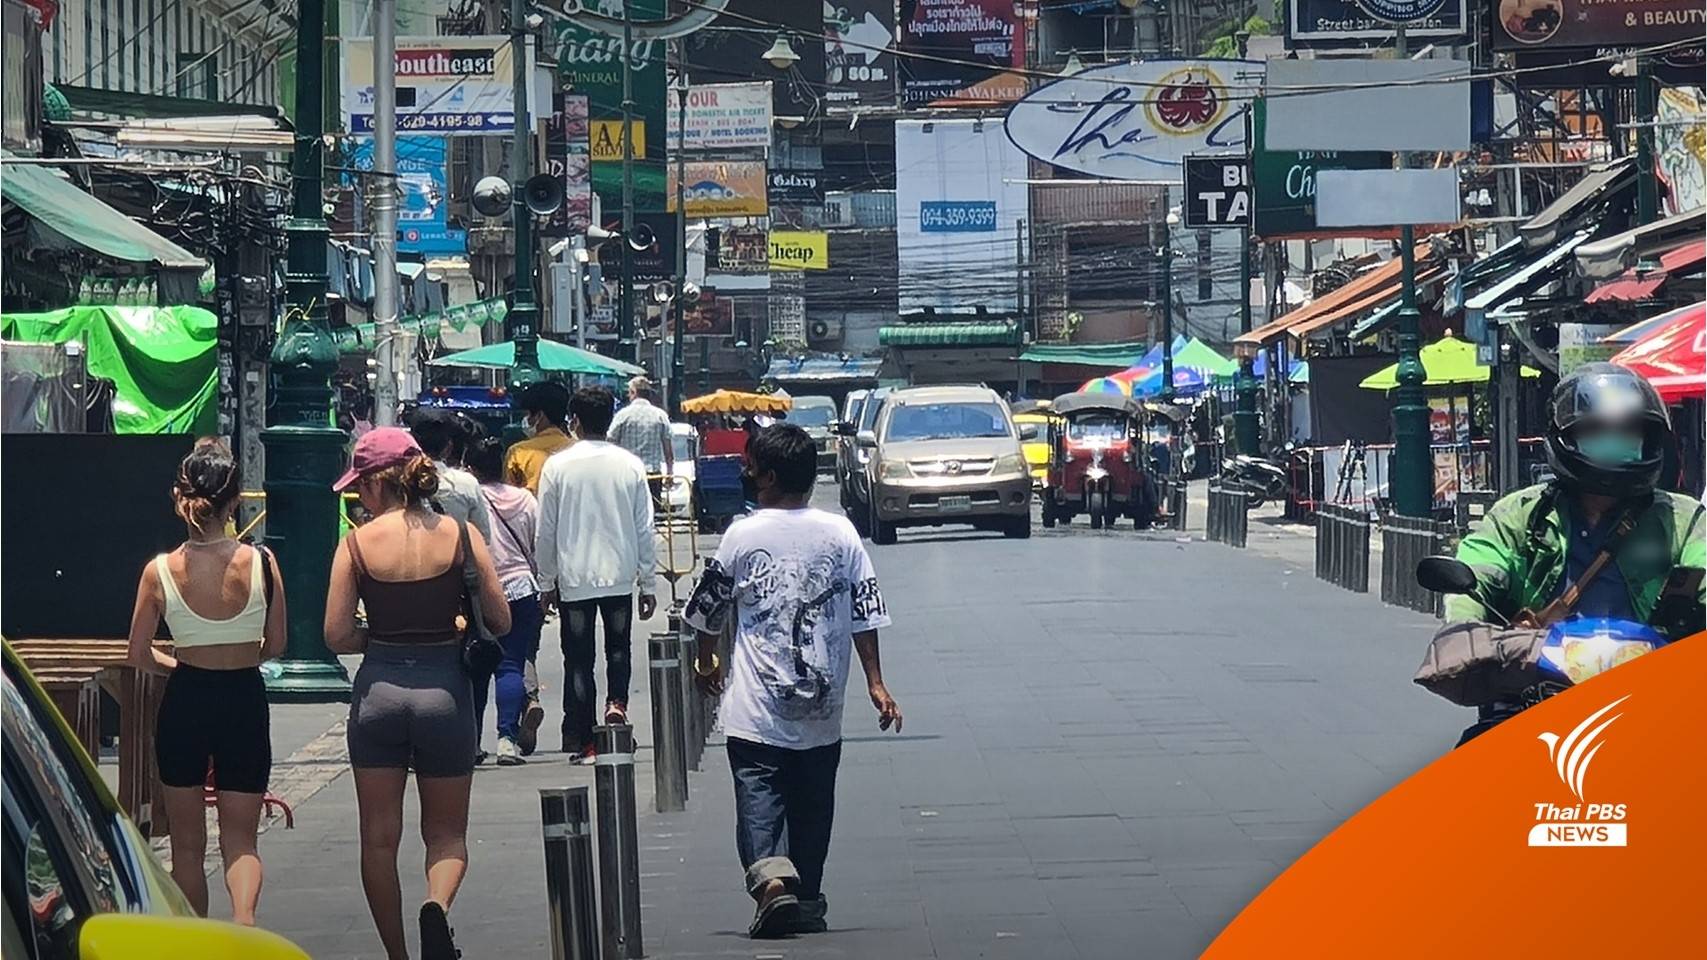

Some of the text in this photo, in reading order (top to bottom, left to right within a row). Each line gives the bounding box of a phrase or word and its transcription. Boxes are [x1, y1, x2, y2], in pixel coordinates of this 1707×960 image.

[1316, 17, 1353, 30] Street
[1356, 17, 1376, 29] bar
[1625, 9, 1706, 26] & BEAUTY
[903, 86, 1025, 103] JOHNNIE WALKER
[361, 117, 376, 128] Te
[922, 207, 995, 226] 094-359-9399
